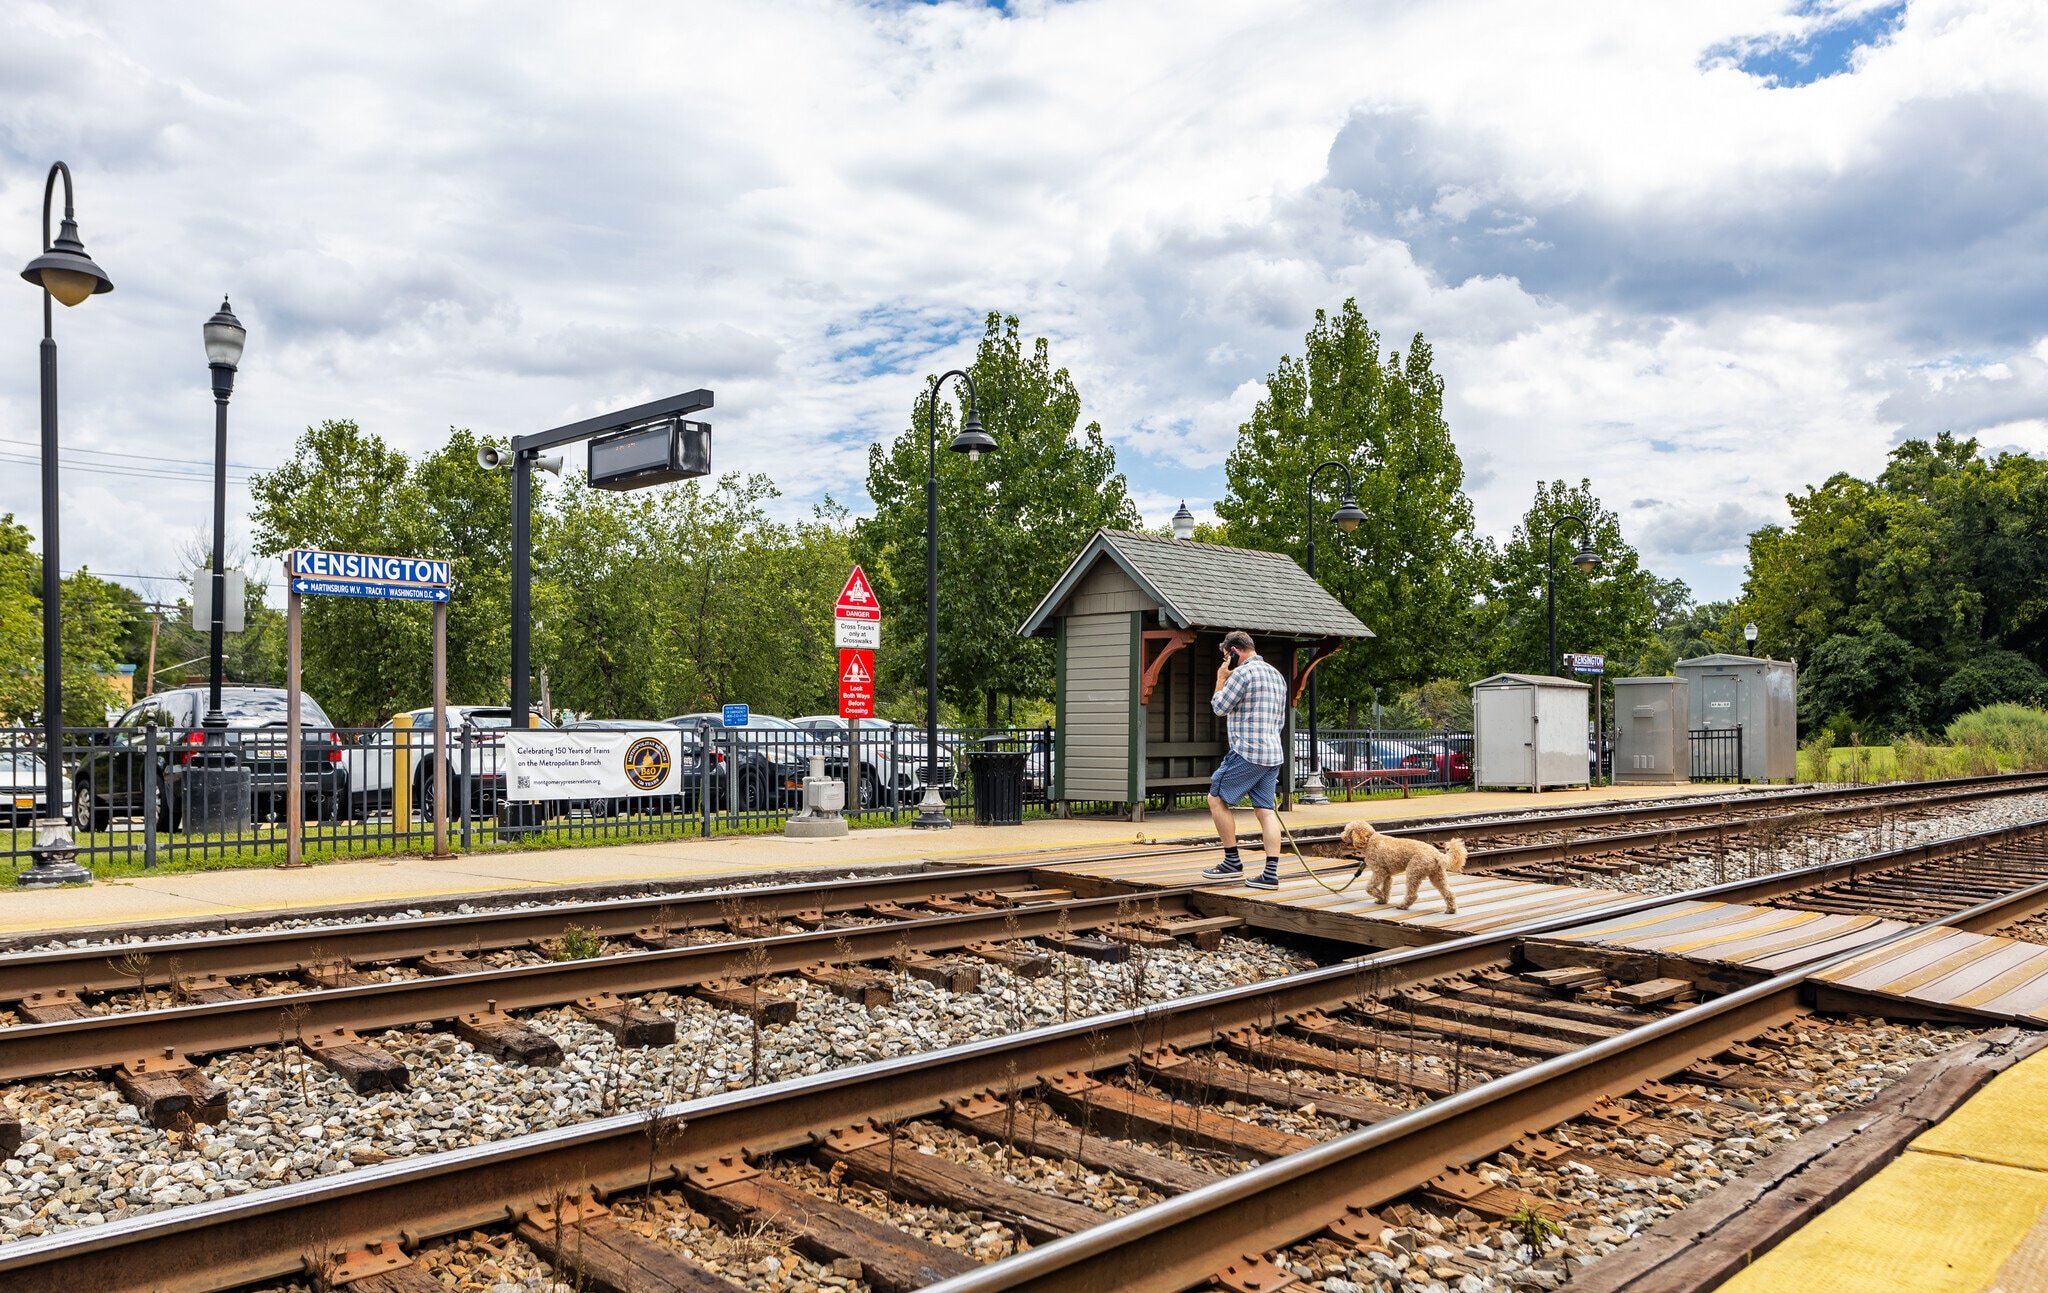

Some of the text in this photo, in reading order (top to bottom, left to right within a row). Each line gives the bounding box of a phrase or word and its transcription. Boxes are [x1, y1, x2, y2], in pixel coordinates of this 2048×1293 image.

[297, 551, 447, 583] KENSINGTON
[310, 583, 349, 593] MARTINSBURG
[349, 585, 362, 594] W.V.
[365, 586, 383, 595] TRACK
[389, 588, 423, 598] WASHINGTON
[424, 591, 434, 599] D.C.
[846, 610, 870, 618] DANGER
[842, 637, 873, 645] Crosswalks
[1574, 655, 1604, 666] KENSINGTON
[855, 692, 870, 700] Ways
[845, 707, 868, 715] Crossing
[517, 747, 554, 757] Celebrating
[593, 746, 610, 754] Trains
[539, 759, 579, 768] Metropolitan
[641, 767, 656, 775] B&O
